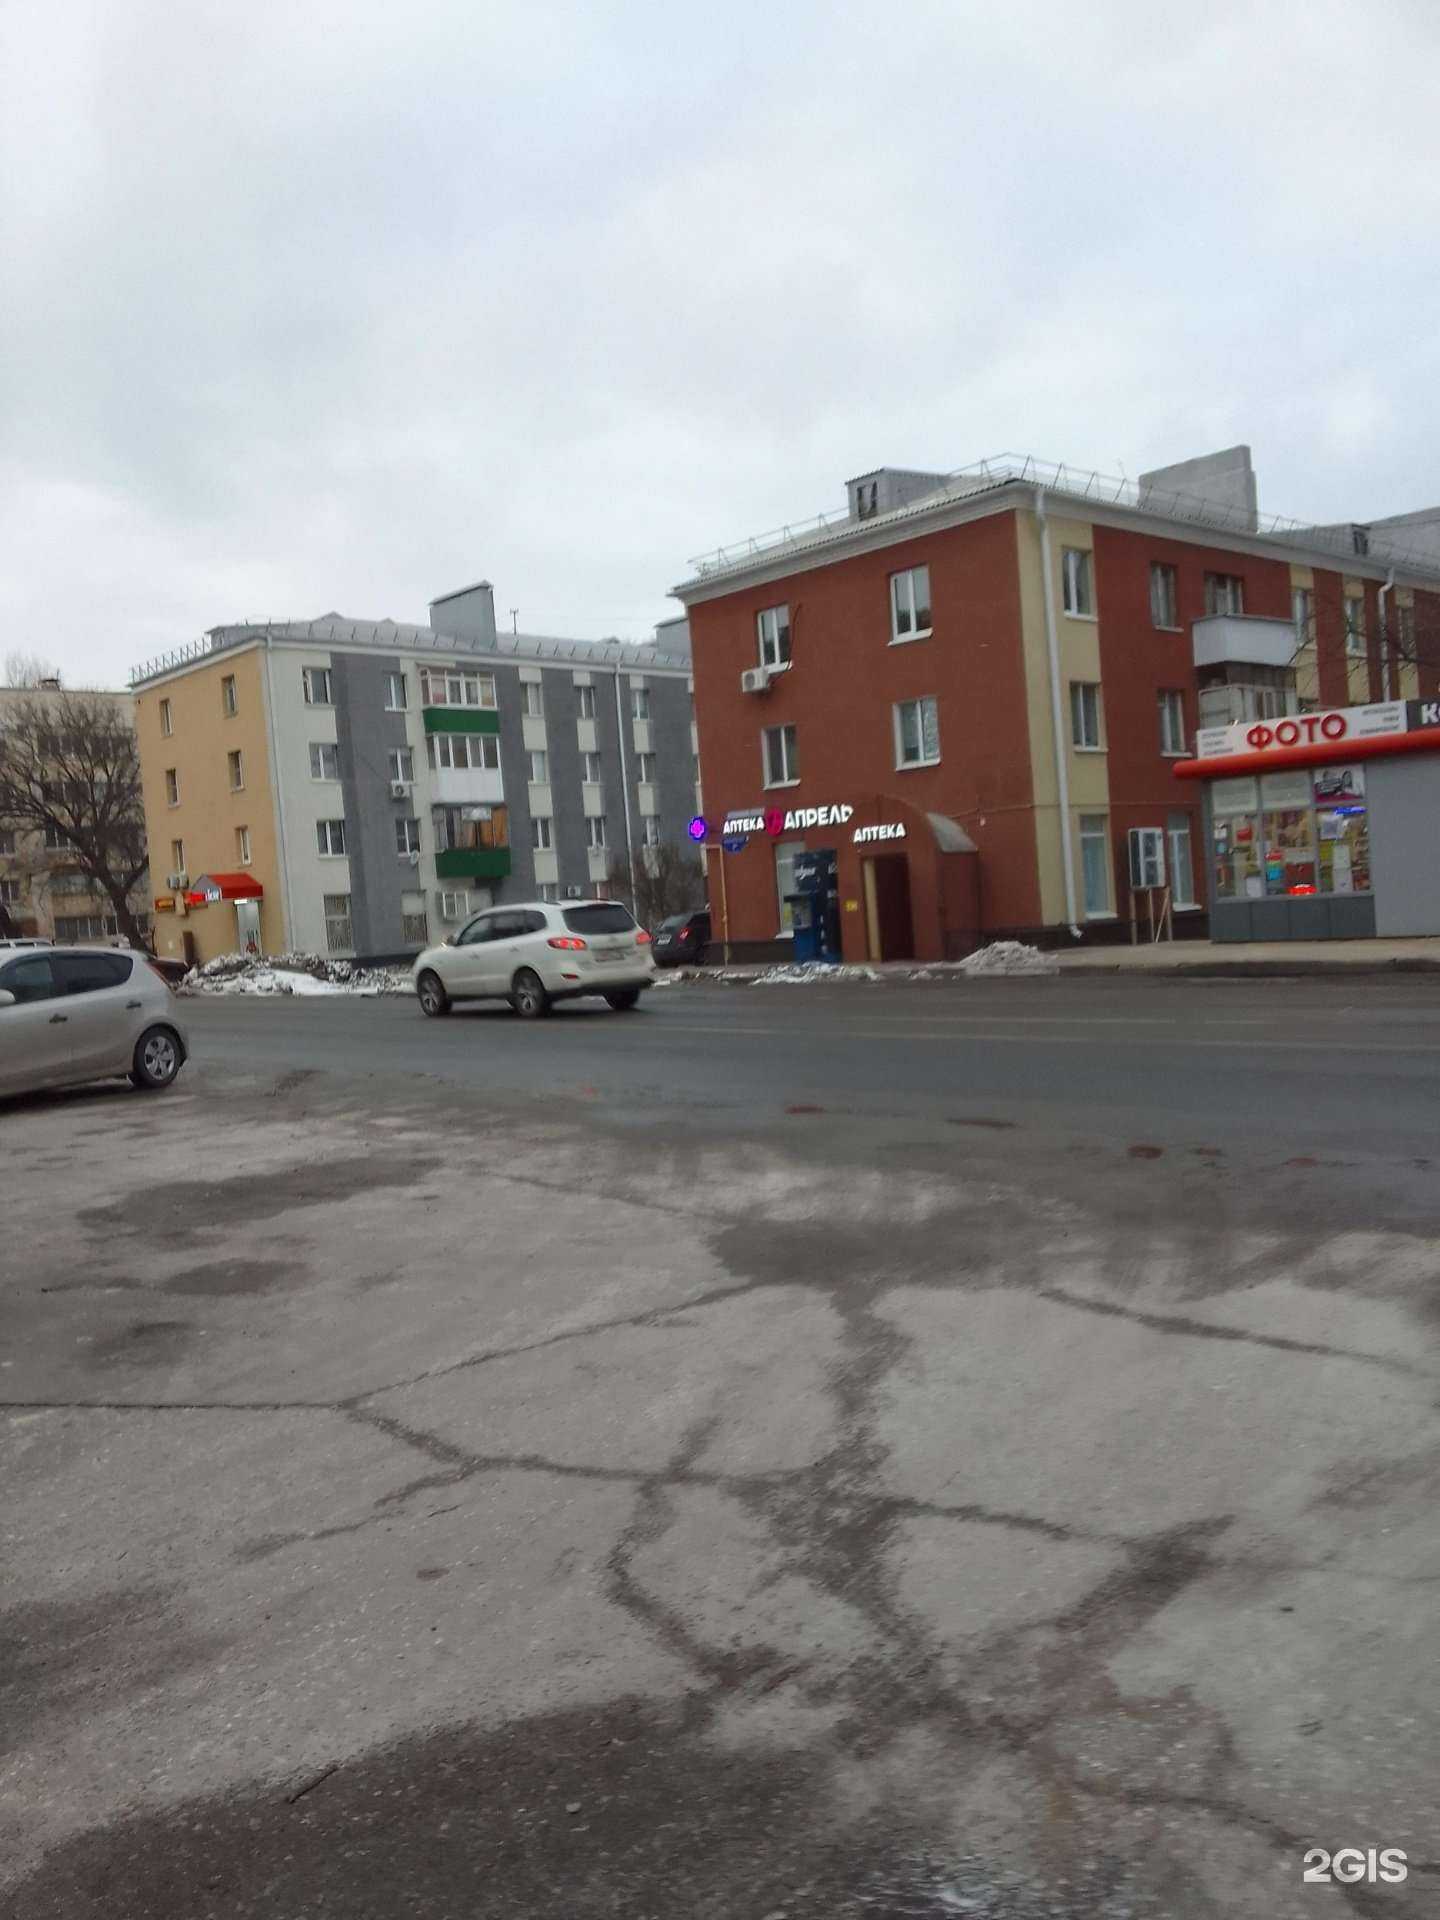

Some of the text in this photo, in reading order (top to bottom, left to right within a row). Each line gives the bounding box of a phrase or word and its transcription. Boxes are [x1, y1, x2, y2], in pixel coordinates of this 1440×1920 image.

[1247, 713, 1347, 750] ФОТО
[723, 803, 854, 834] АПТЕКА АПРЕЛЬ
[853, 823, 906, 843] АПТЕКА
